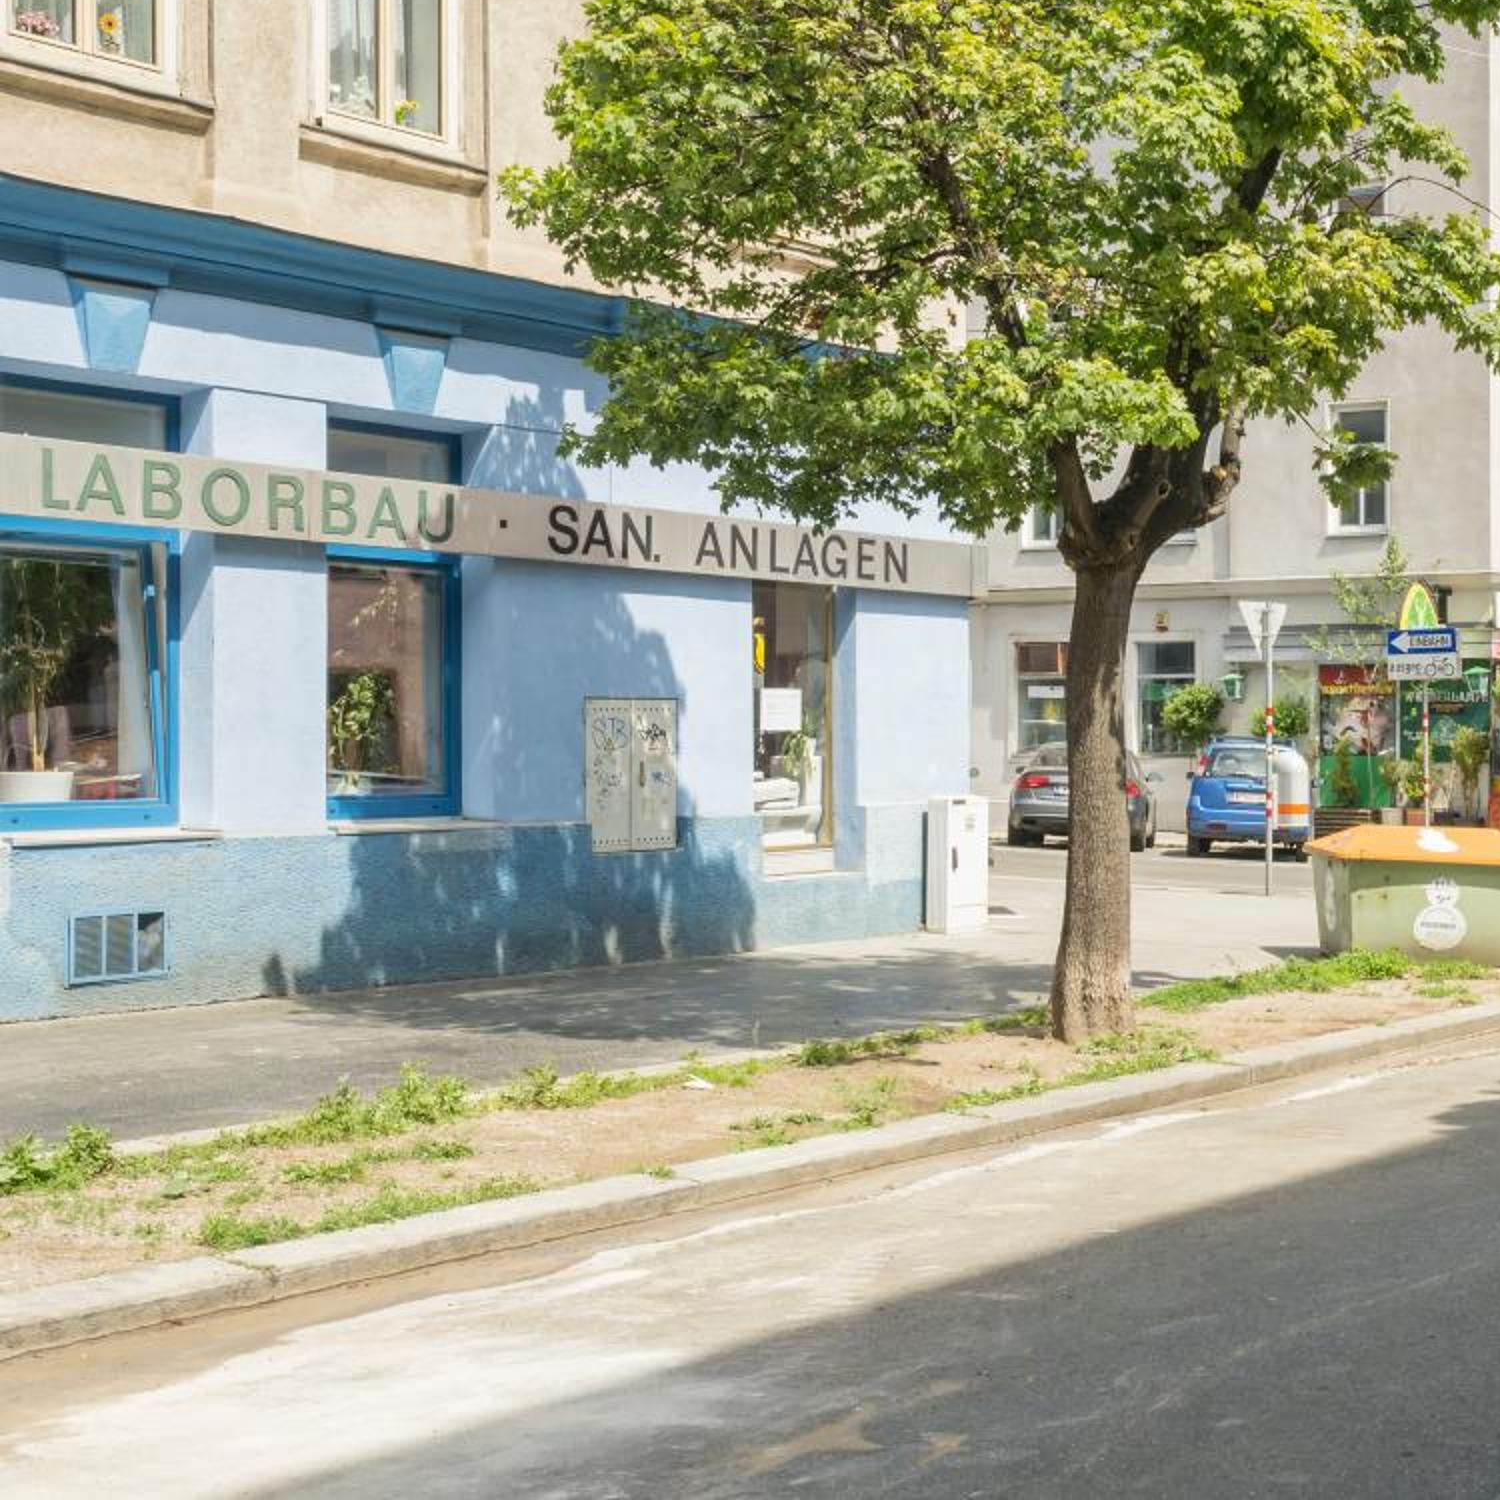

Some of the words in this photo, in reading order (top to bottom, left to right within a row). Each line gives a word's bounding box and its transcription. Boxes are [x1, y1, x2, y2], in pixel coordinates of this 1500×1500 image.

[41, 448, 456, 543] LABORBAU
[546, 504, 661, 563] SAN.
[695, 521, 909, 583] ANLAGEN
